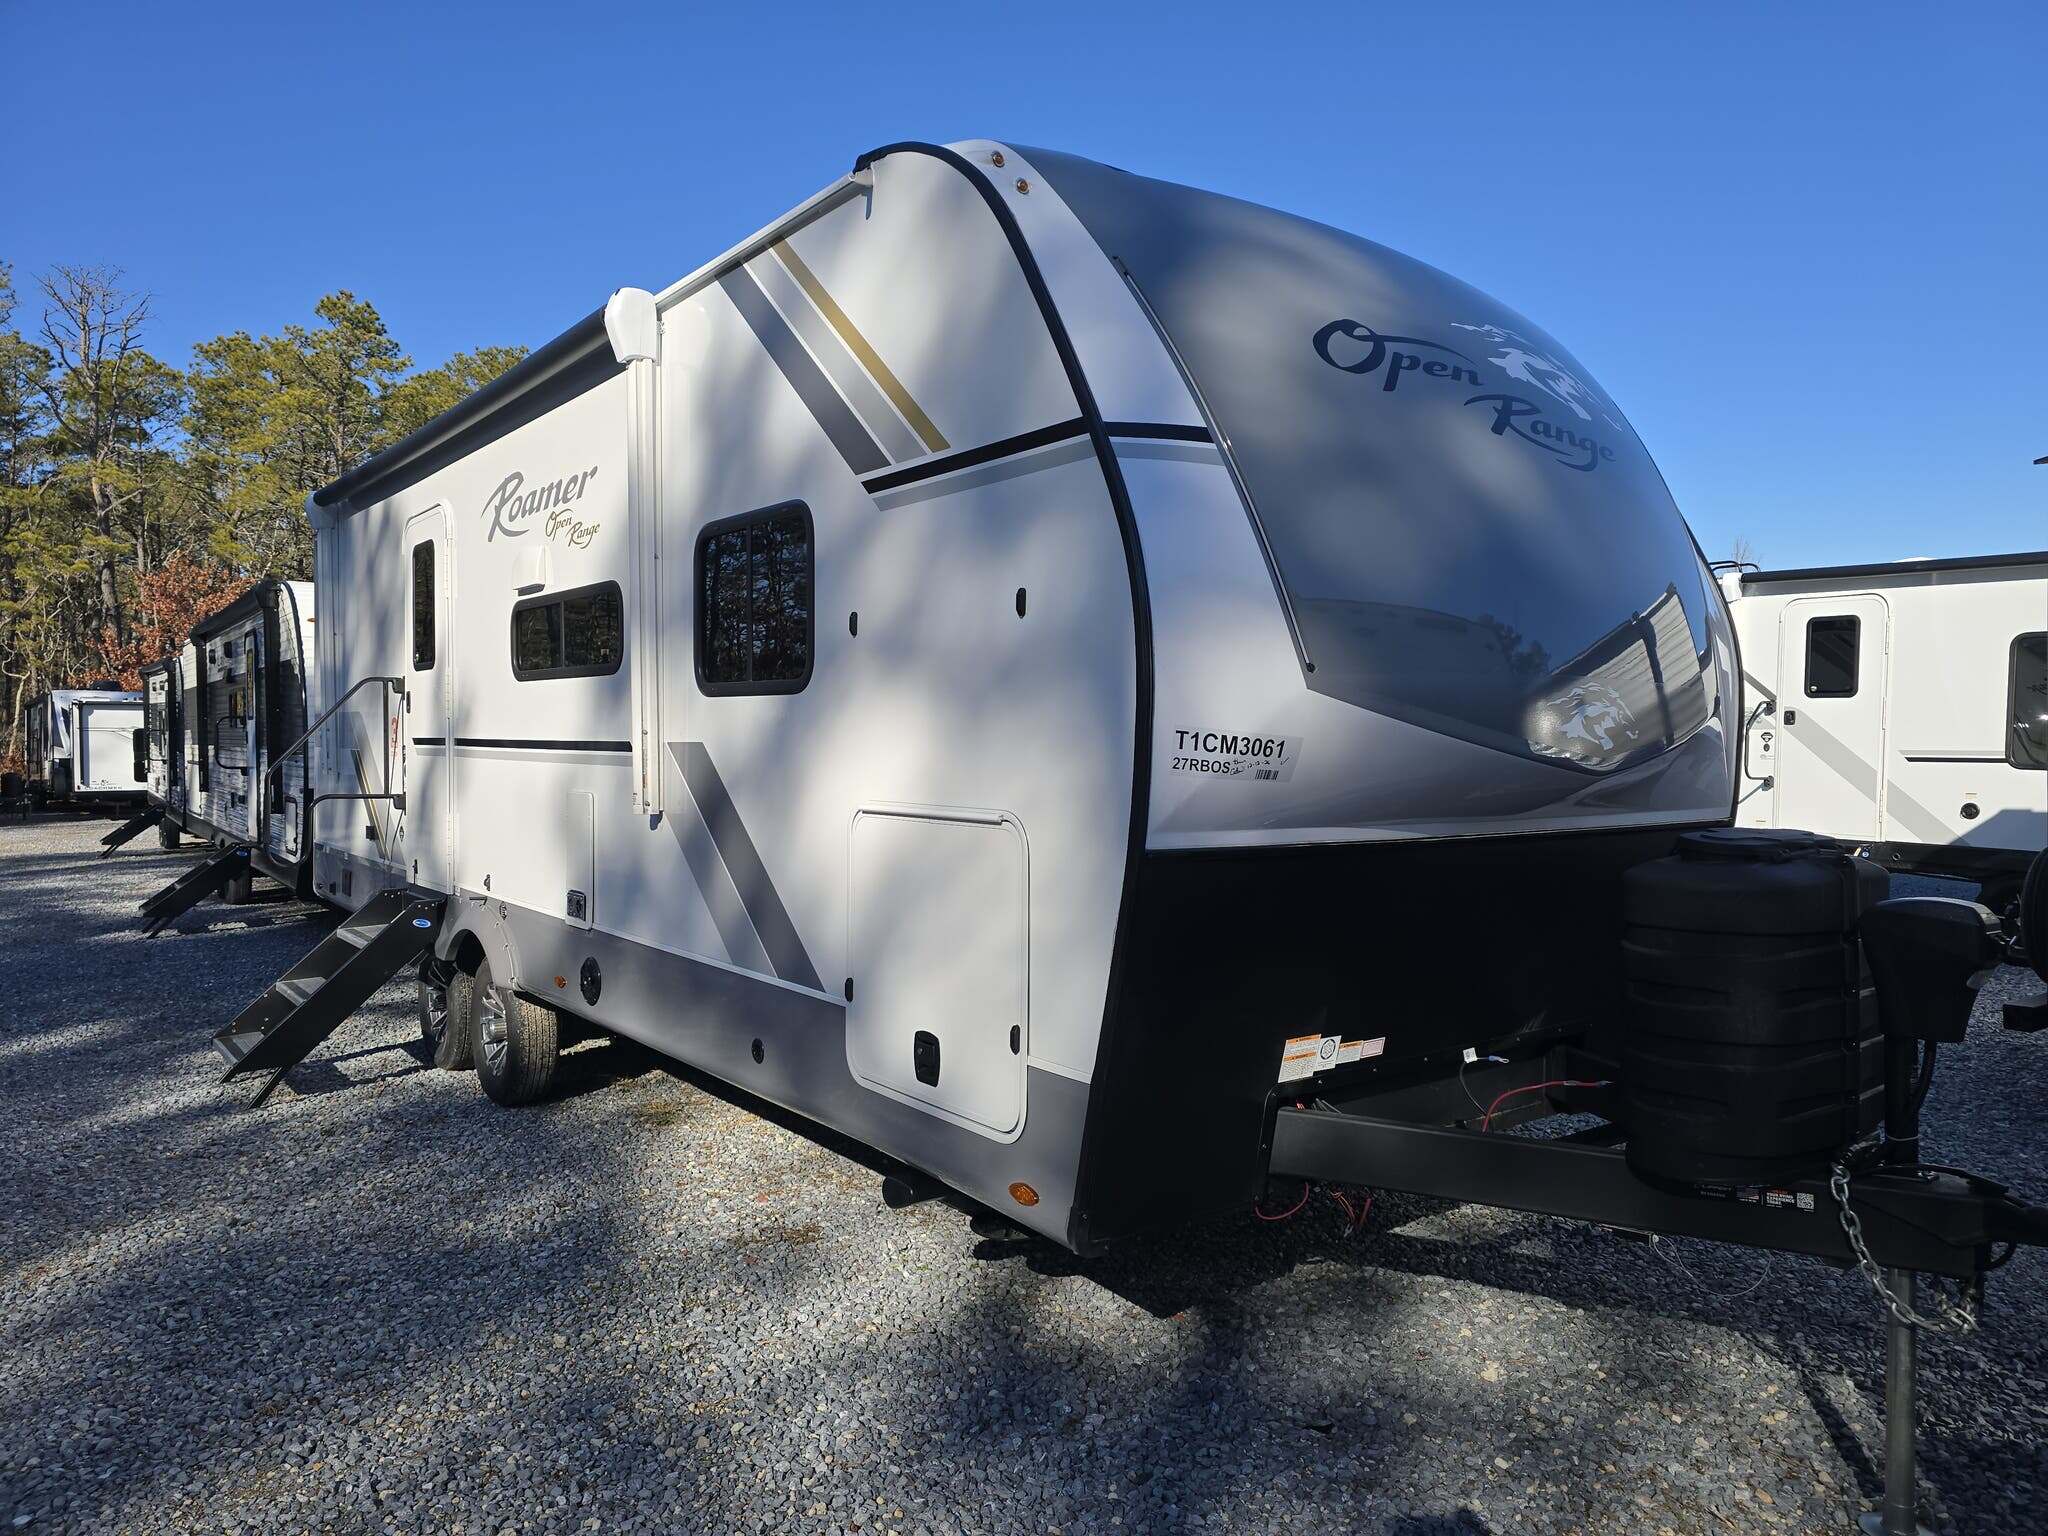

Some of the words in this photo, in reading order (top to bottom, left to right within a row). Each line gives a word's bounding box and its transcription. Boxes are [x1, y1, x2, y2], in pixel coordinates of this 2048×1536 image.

[1312, 318, 1485, 392] Open
[1463, 393, 1617, 472] Range
[480, 465, 598, 543] Roamer
[545, 508, 574, 541] Open
[565, 521, 601, 549] Range
[1175, 729, 1286, 759] T1CM3061
[1172, 757, 1231, 774] 27RBOS
